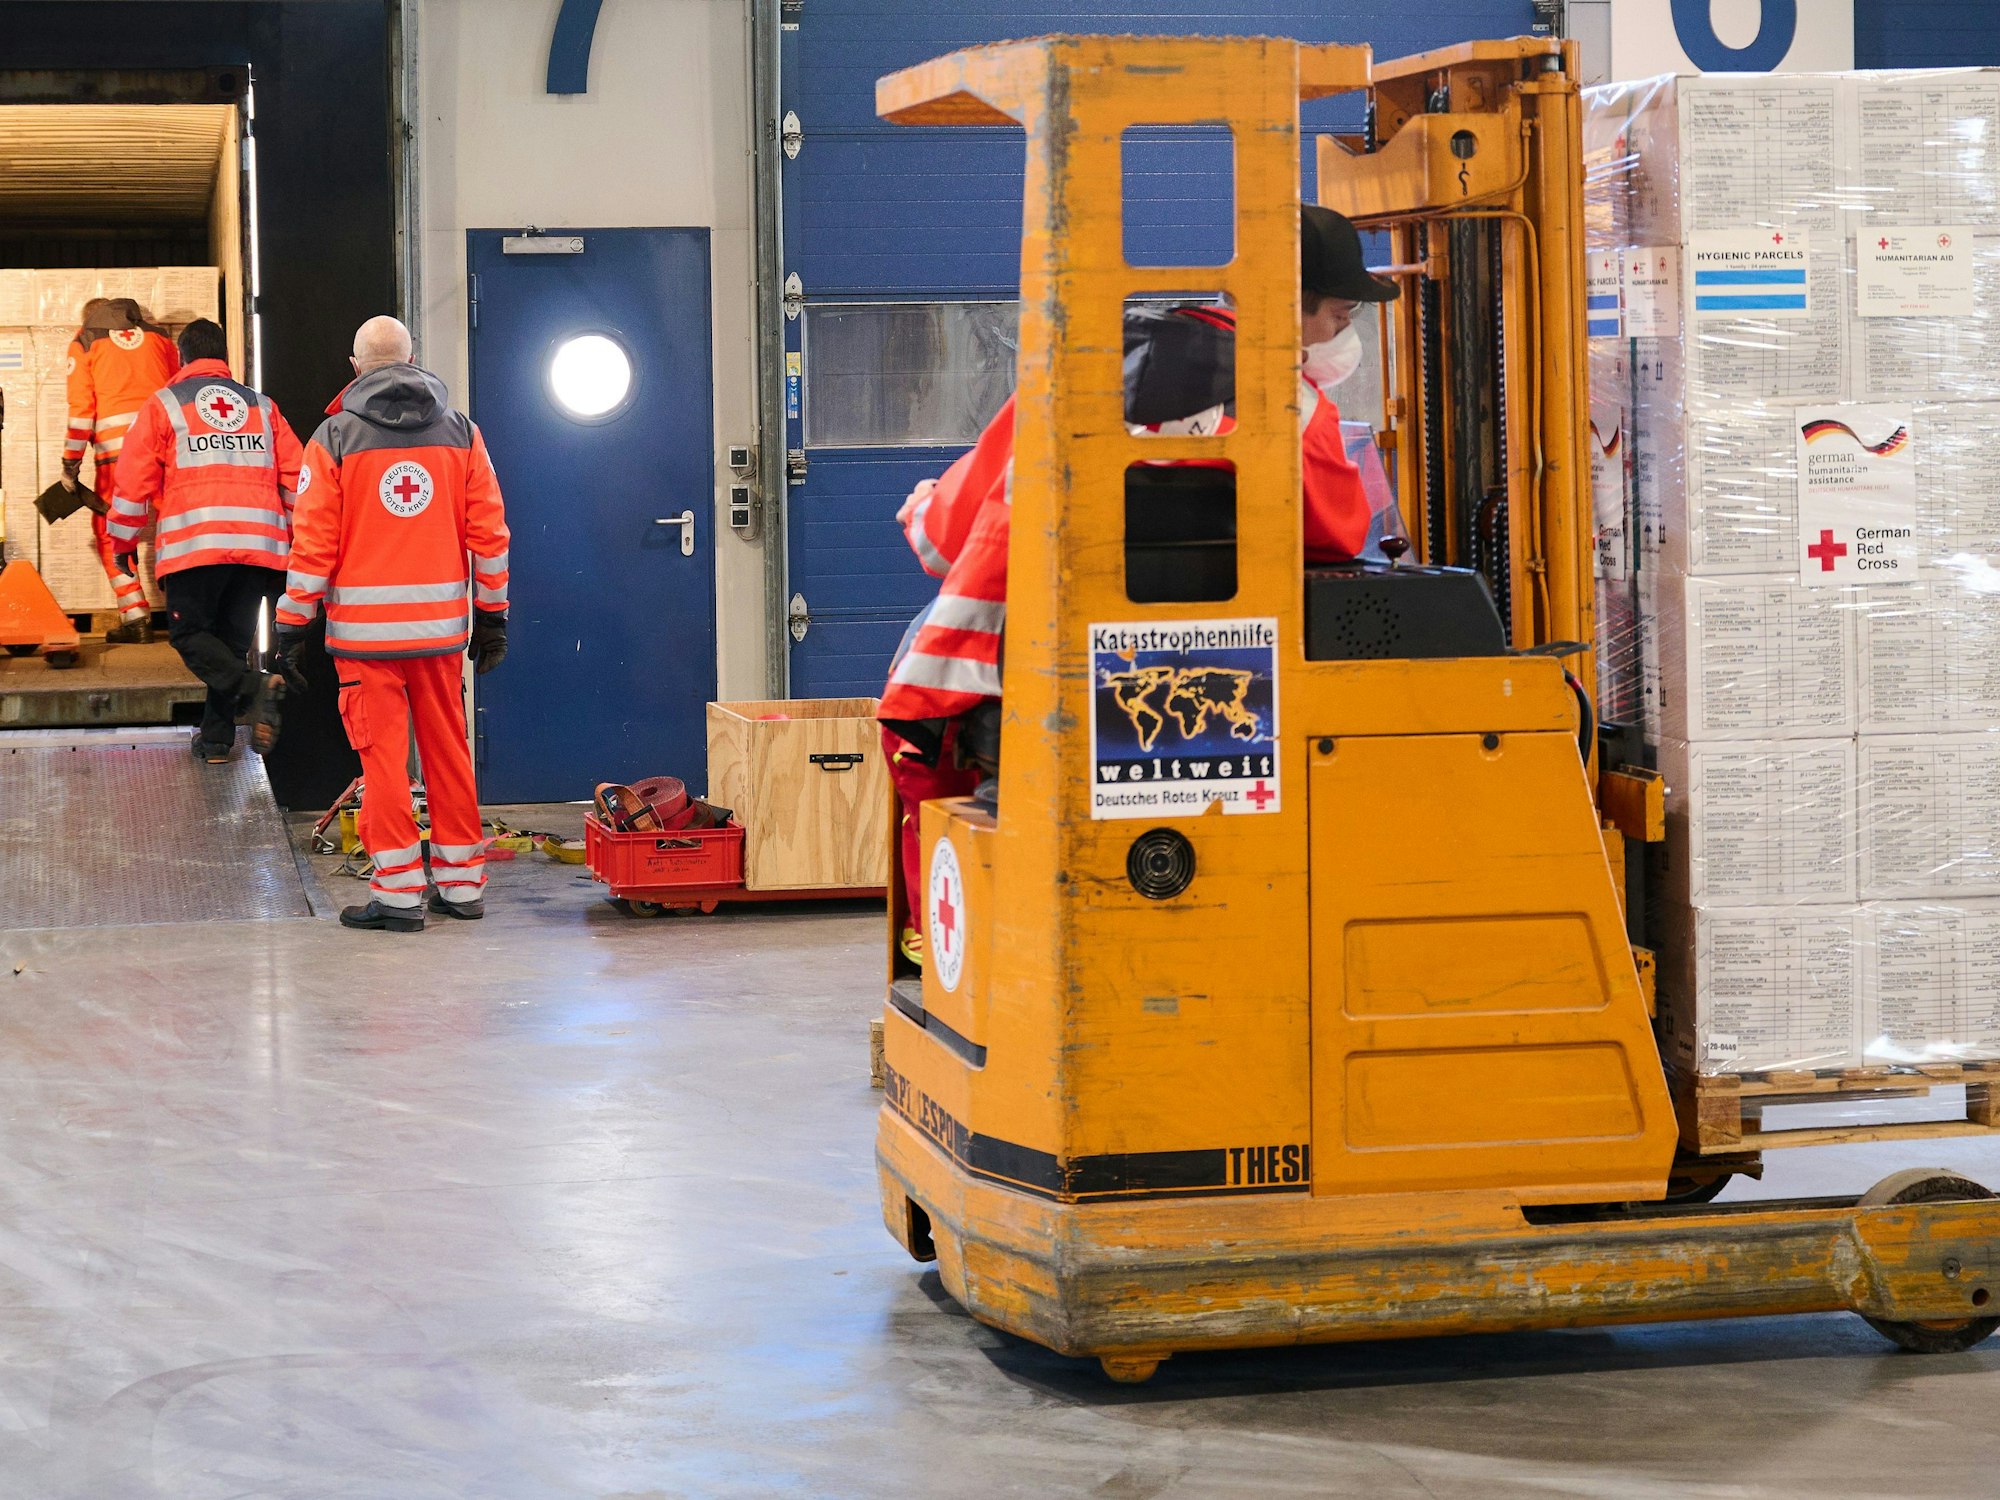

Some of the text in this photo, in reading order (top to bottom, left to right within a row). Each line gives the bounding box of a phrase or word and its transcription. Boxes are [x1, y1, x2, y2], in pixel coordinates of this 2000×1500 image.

[1697, 251, 1804, 261] HYGIENIC PARCELS
[200, 388, 241, 405] DEUTSCHES
[201, 407, 245, 428] ROTES KREUZ
[188, 434, 265, 452] LOGISTIK
[1808, 452, 1855, 466] german
[385, 465, 428, 485] DEUTSCHES
[1808, 466, 1868, 475] humanitarian
[1808, 475, 1854, 484] assistance
[384, 490, 429, 513] ROTES KREUZ
[1599, 524, 1621, 537] German
[1856, 527, 1911, 540] German
[1599, 539, 1611, 551] Red
[1857, 542, 1884, 555] Red
[1600, 554, 1616, 567] Cross
[1857, 558, 1898, 570] Cross
[1094, 624, 1273, 655] Katastrophenhilfe
[1100, 755, 1271, 782] weltweit
[1096, 789, 1239, 807] Deutsches Rotes Kreuz
[1229, 1144, 1309, 1185] THESI
